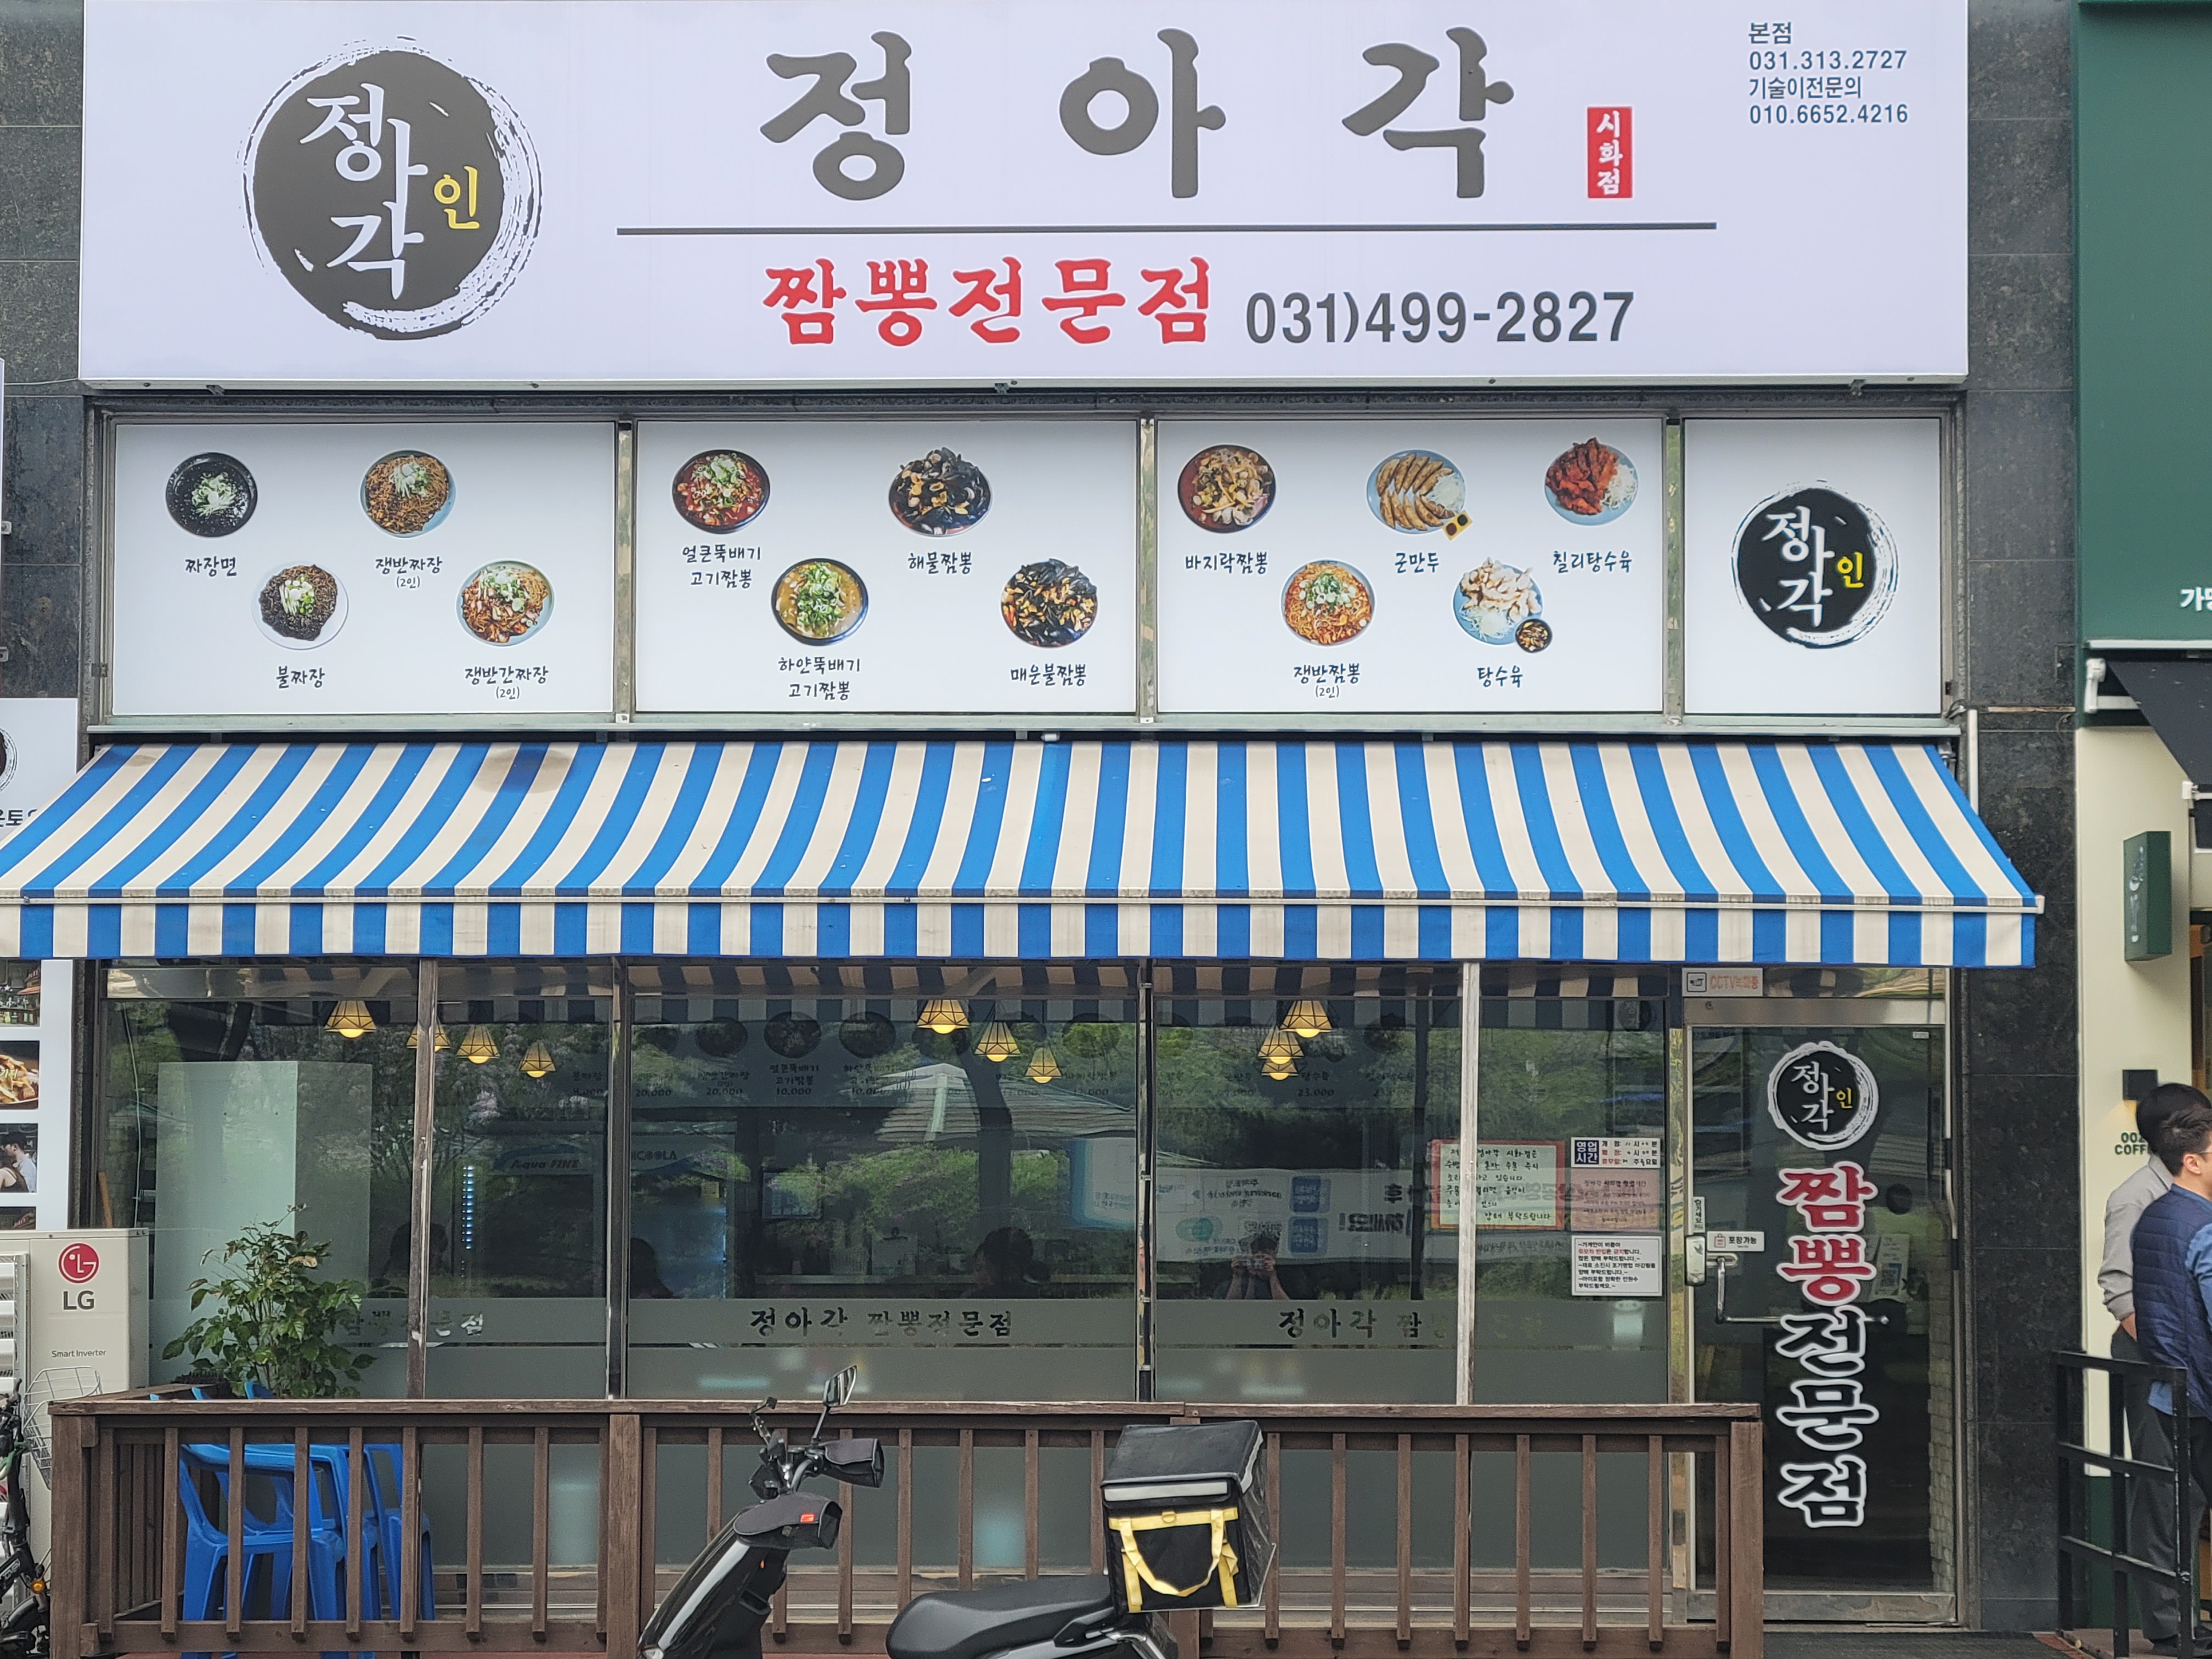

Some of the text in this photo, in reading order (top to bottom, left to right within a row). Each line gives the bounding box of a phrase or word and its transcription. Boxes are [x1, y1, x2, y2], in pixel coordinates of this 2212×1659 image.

[1749, 22, 1791, 44] 본점
[1750, 50, 1906, 70] 031.313.2727
[1750, 77, 1860, 99] 기술이전문의
[760, 27, 1514, 200] 정아각
[1751, 104, 1907, 123] 010.6652.4216
[1596, 110, 1623, 195] 시화점
[300, 83, 480, 300] 정아각 인
[764, 258, 1208, 346] 짬뽕전문점
[1247, 291, 1633, 343] 031)499-2827
[683, 544, 760, 562] 얼큰뚝배기
[909, 552, 972, 574] 해물짬뽕
[1186, 552, 1267, 574] 바지락짬뽕
[1395, 552, 1438, 573] 군만두
[1554, 551, 1632, 573] 칠리탕수육
[185, 556, 236, 577] 짜장면
[376, 556, 442, 574] 쟁반짜장
[1762, 506, 1864, 627] 정아각 인
[397, 577, 420, 588] (2인)
[691, 569, 751, 588] 고기짬뽕
[465, 666, 548, 685] 쟁반간짜장
[778, 657, 859, 674] 하얀뚝배기
[1011, 664, 1086, 686] 매운불짬뽕
[1294, 664, 1359, 684] 쟁반짬뽕
[1477, 665, 1522, 687] 탕수육
[276, 666, 325, 689] 불짜장
[496, 687, 519, 699] (2인)
[789, 681, 849, 700] 고기짬뽕
[1316, 686, 1339, 698] (2인)
[1791, 1061, 1851, 1132] 정아각 인
[1576, 1142, 1598, 1152] 영업
[1576, 1153, 1598, 1163] 시간
[64, 1291, 94, 1310] LG
[1278, 1308, 1377, 1339] 정아각
[1778, 1161, 1878, 1528] 짬뽕전문점
